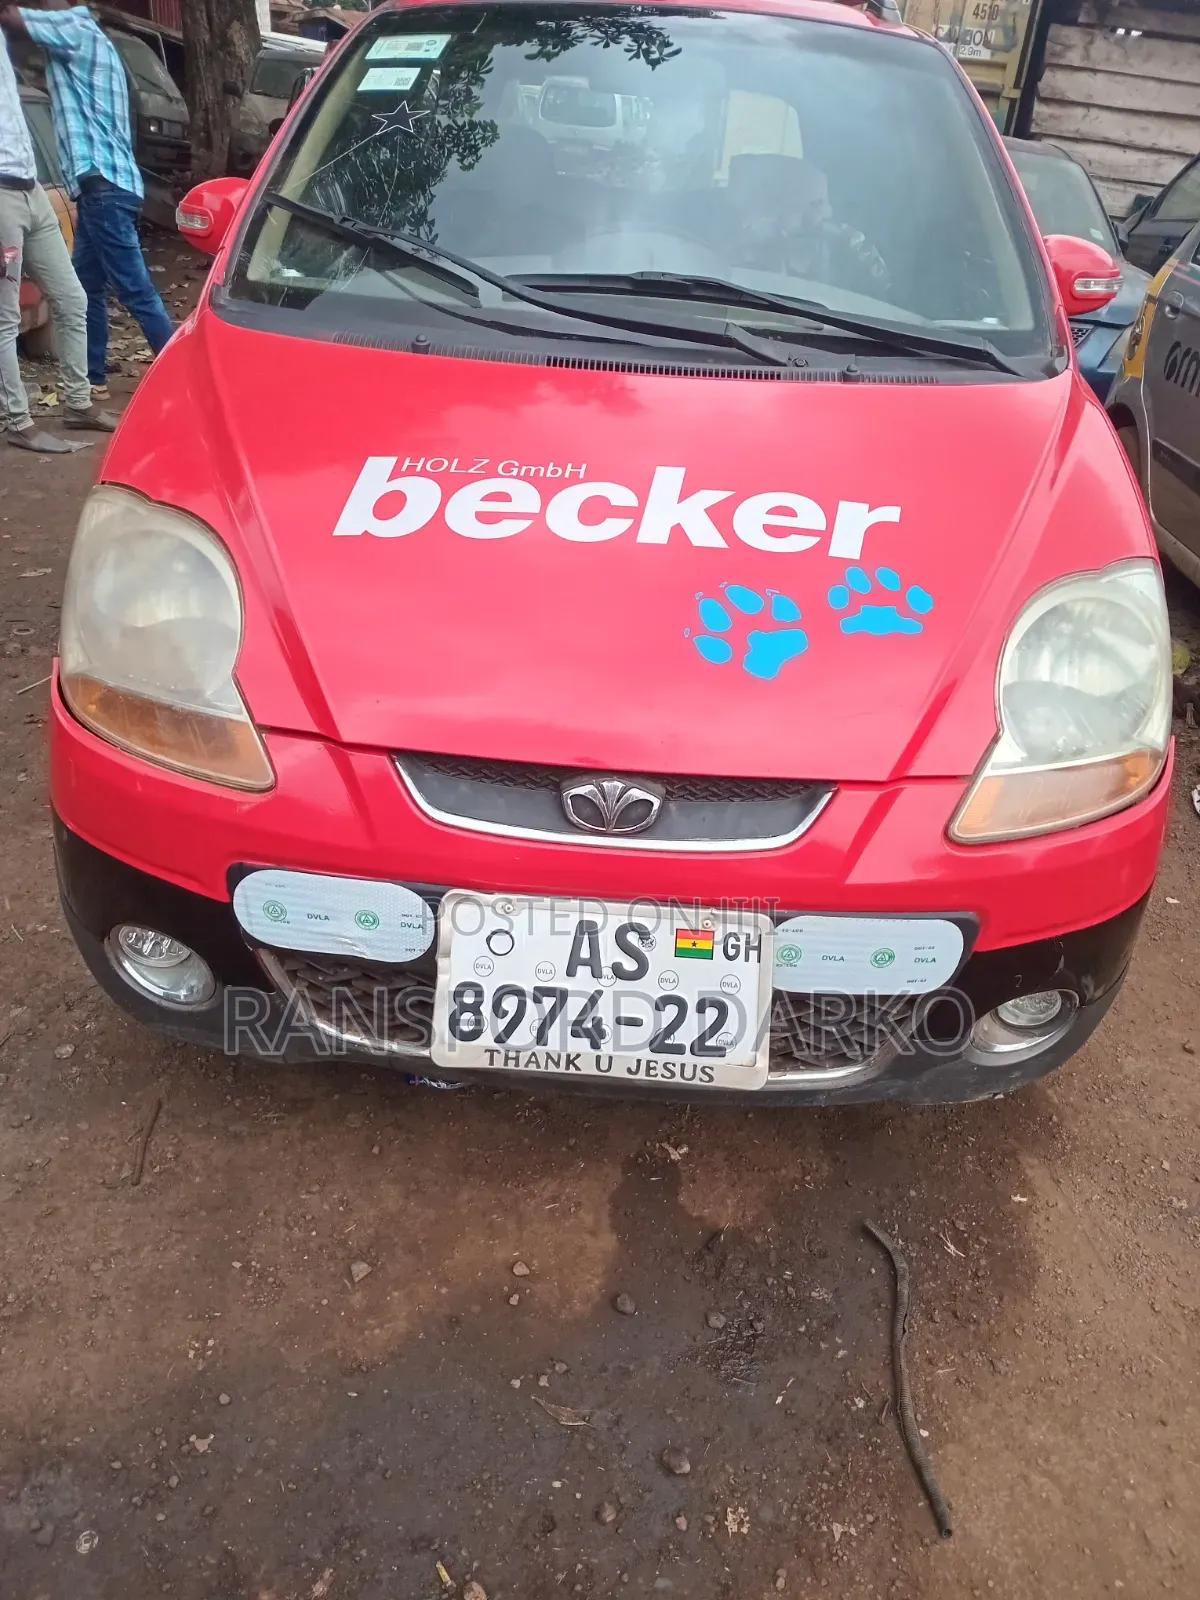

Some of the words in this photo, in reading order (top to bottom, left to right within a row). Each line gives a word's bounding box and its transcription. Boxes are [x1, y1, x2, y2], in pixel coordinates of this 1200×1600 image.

[972, 2, 1000, 21] 4510
[400, 456, 488, 475] HOLZ
[496, 459, 588, 480] GmbH
[332, 455, 902, 560] becker
[306, 913, 330, 921] DVLA
[400, 921, 424, 930] DVLA
[566, 919, 650, 981] AS
[722, 931, 762, 964] GH
[821, 954, 845, 962] DVLA
[475, 962, 492, 971] DVLA
[537, 967, 554, 975] DVLA
[660, 976, 677, 984] DVLA
[722, 981, 739, 989] DVLA
[448, 980, 729, 1058] 8974-22
[484, 1048, 583, 1073] THANK
[595, 1054, 614, 1074] U
[626, 1057, 715, 1084] JESUS
